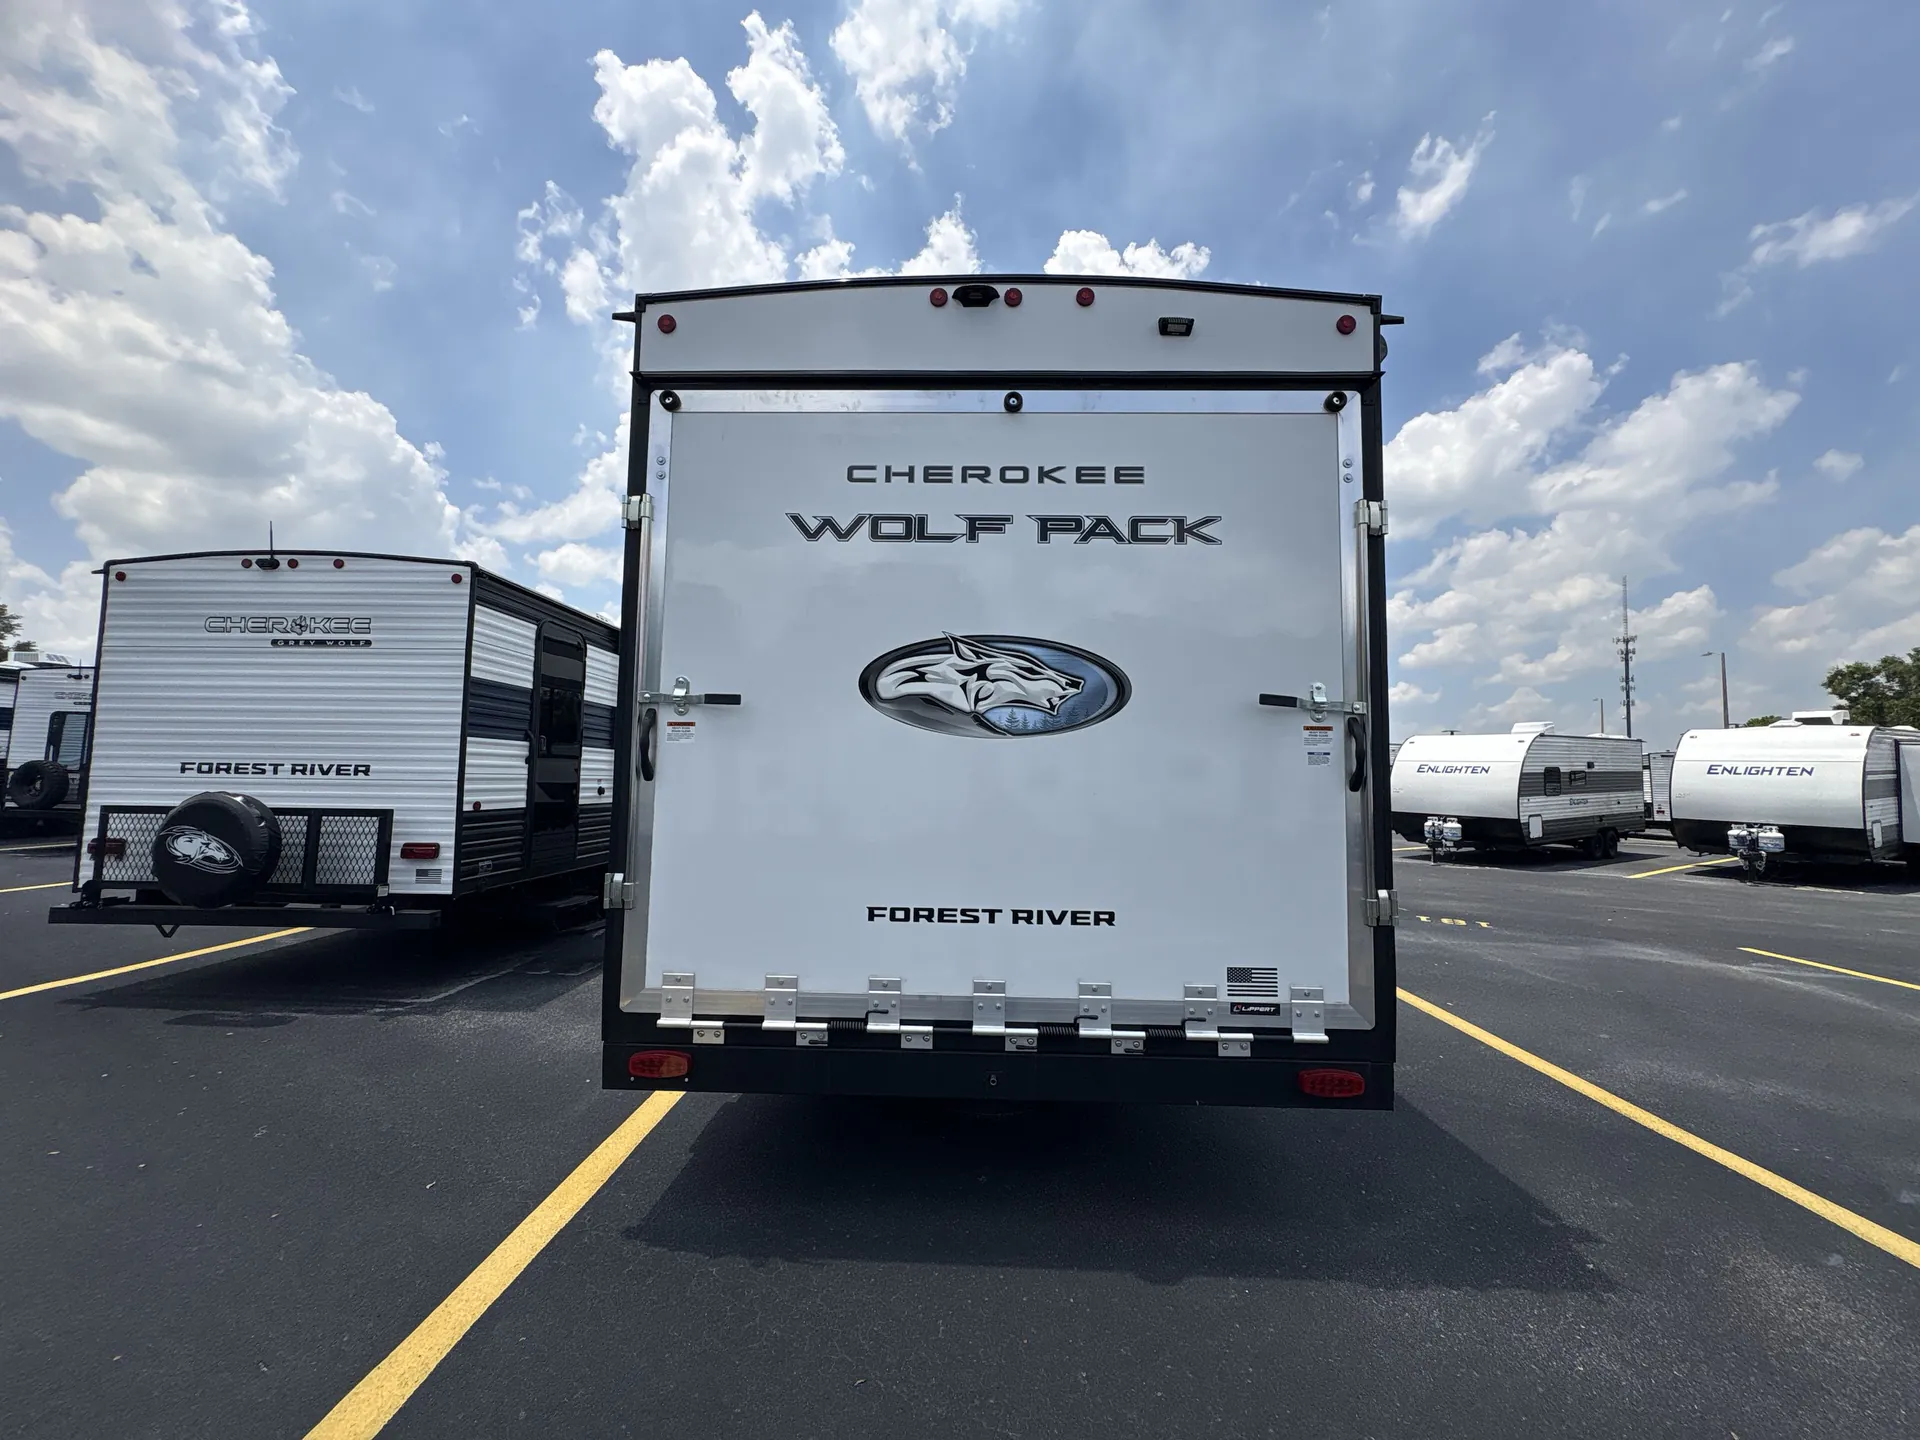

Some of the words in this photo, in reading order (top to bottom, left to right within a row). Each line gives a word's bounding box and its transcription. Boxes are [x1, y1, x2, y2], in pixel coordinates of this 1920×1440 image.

[847, 465, 1145, 484] CHEROKEE
[785, 512, 1013, 543] WOLF
[1026, 514, 1222, 545] PACK
[180, 762, 285, 775] FOREST
[290, 764, 371, 776] RIVER
[866, 906, 1003, 924] FOREST
[1010, 909, 1116, 926] RIVER
